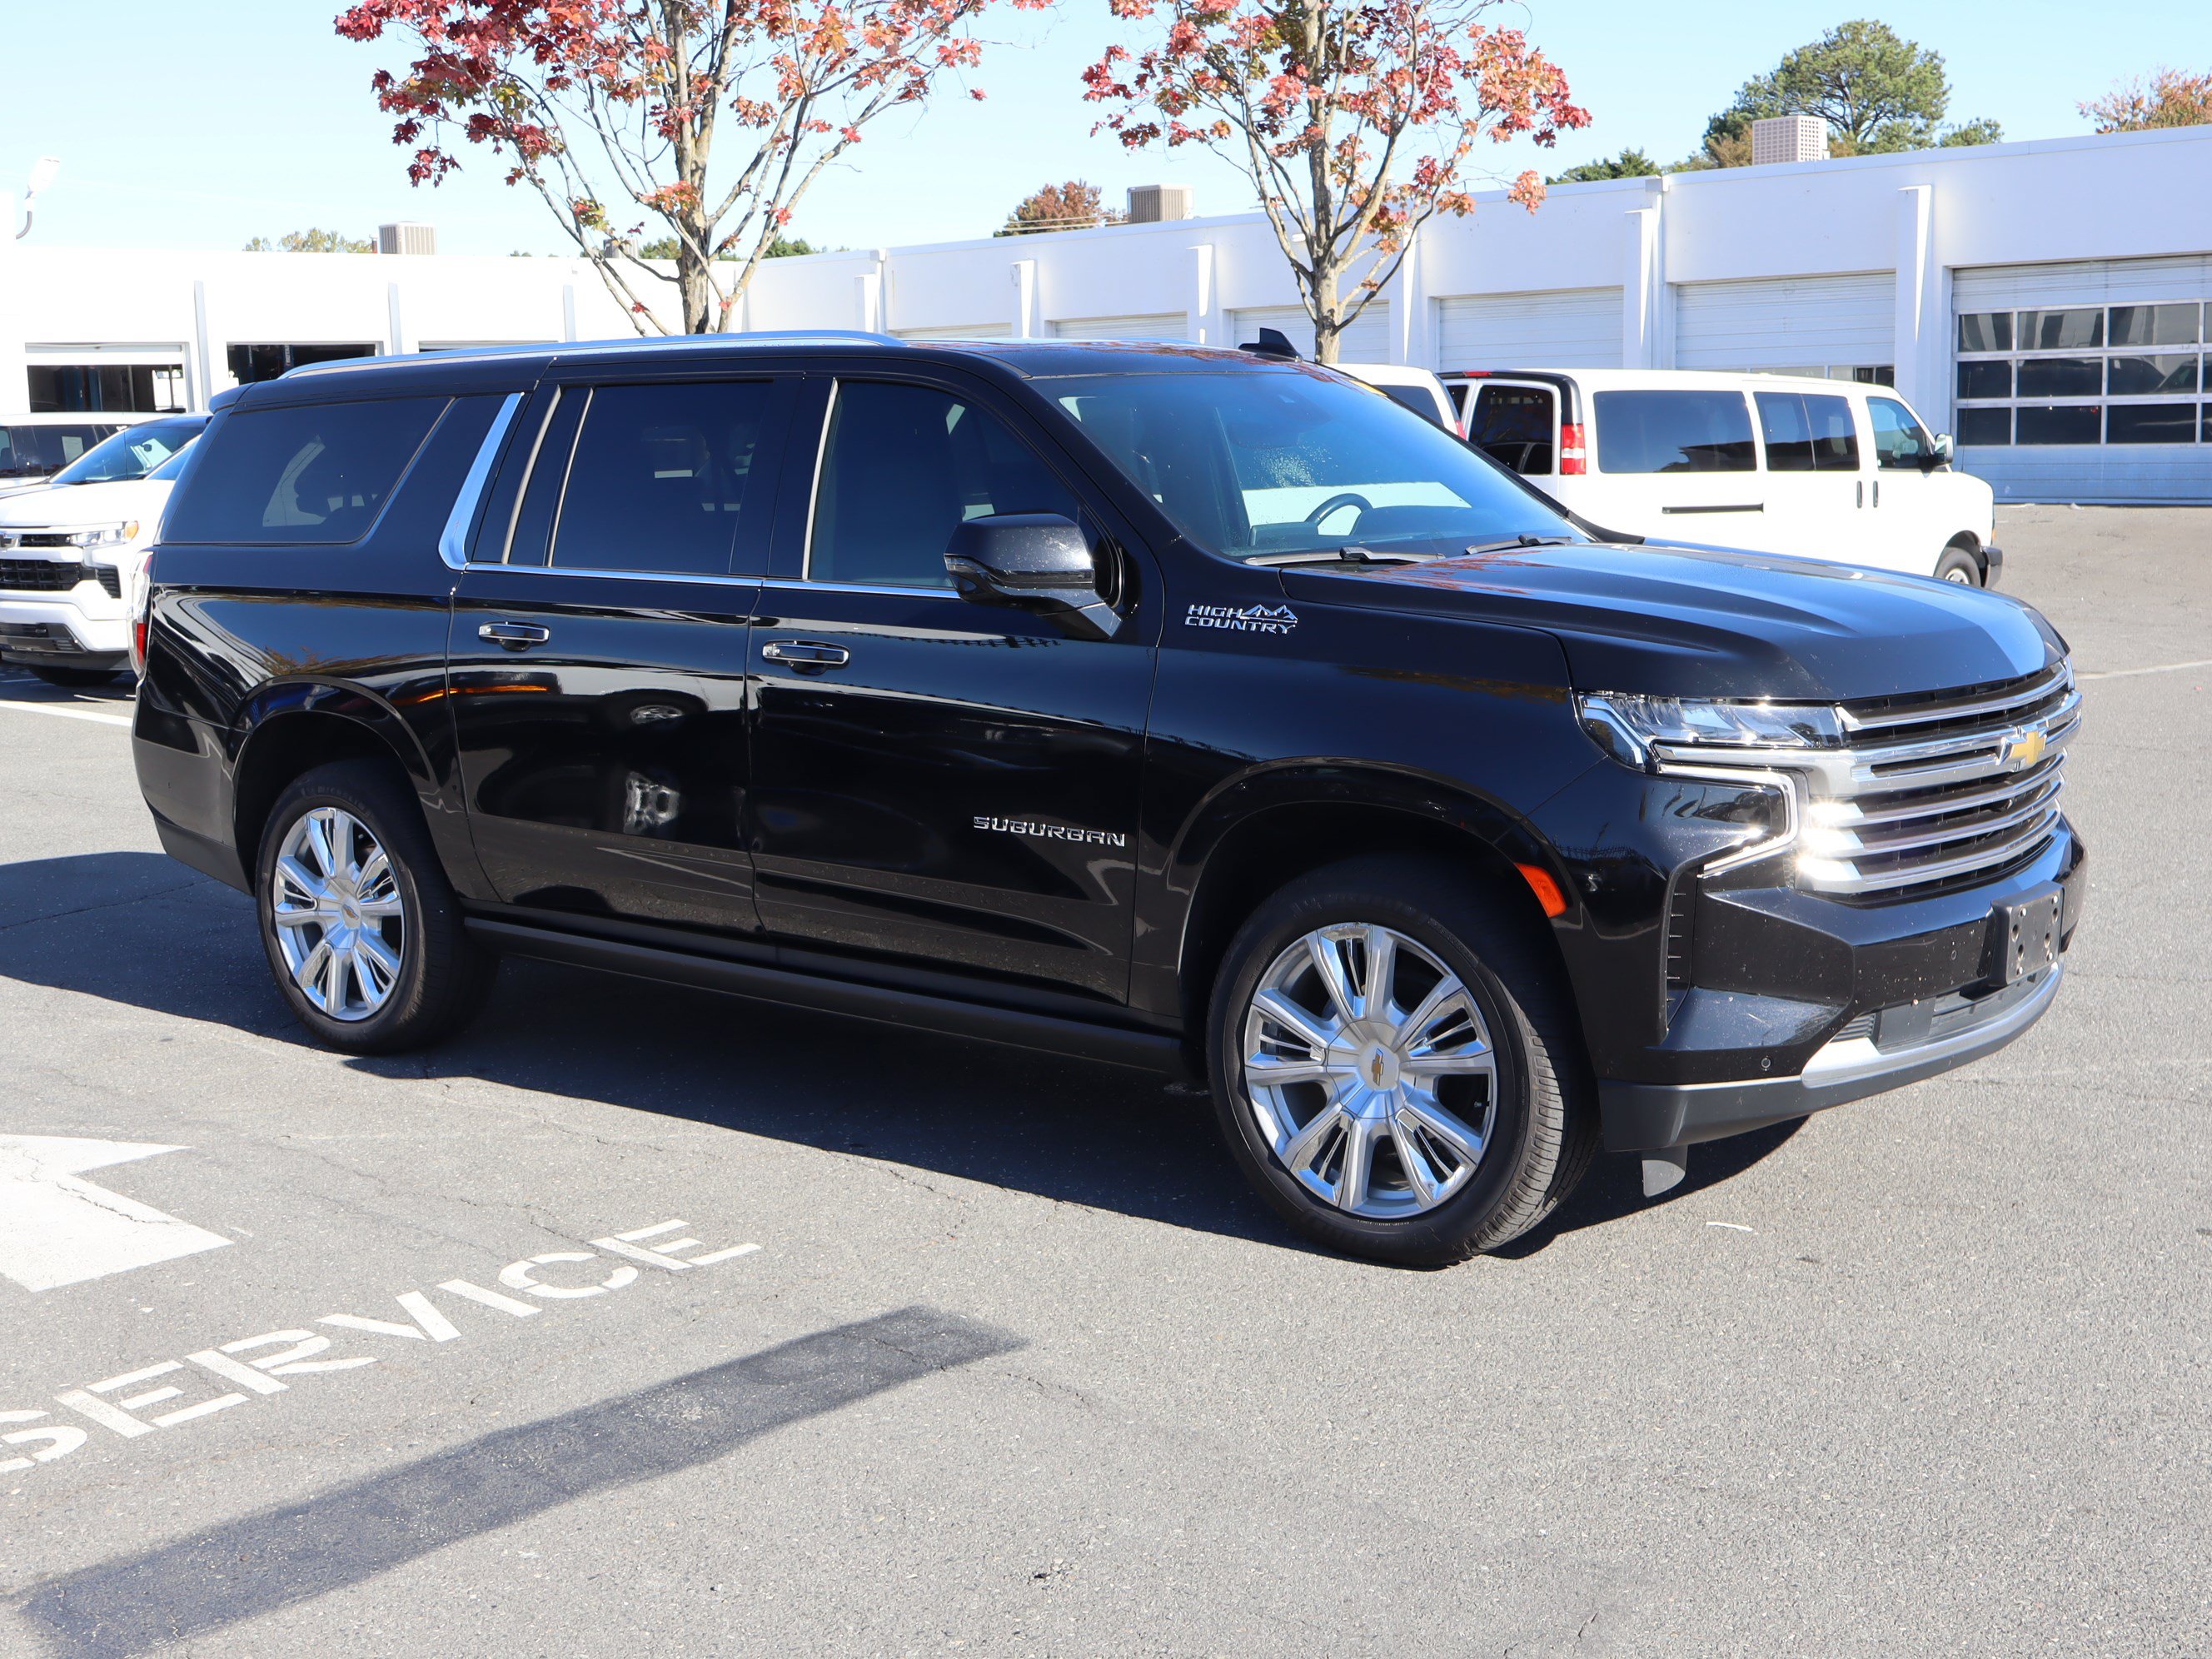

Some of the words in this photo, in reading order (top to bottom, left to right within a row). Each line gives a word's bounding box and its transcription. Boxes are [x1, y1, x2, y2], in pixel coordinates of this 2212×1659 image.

[1188, 604, 1243, 618] HIGH
[1184, 615, 1296, 634] COUNTRY
[974, 816, 1124, 847] SUBURBAN
